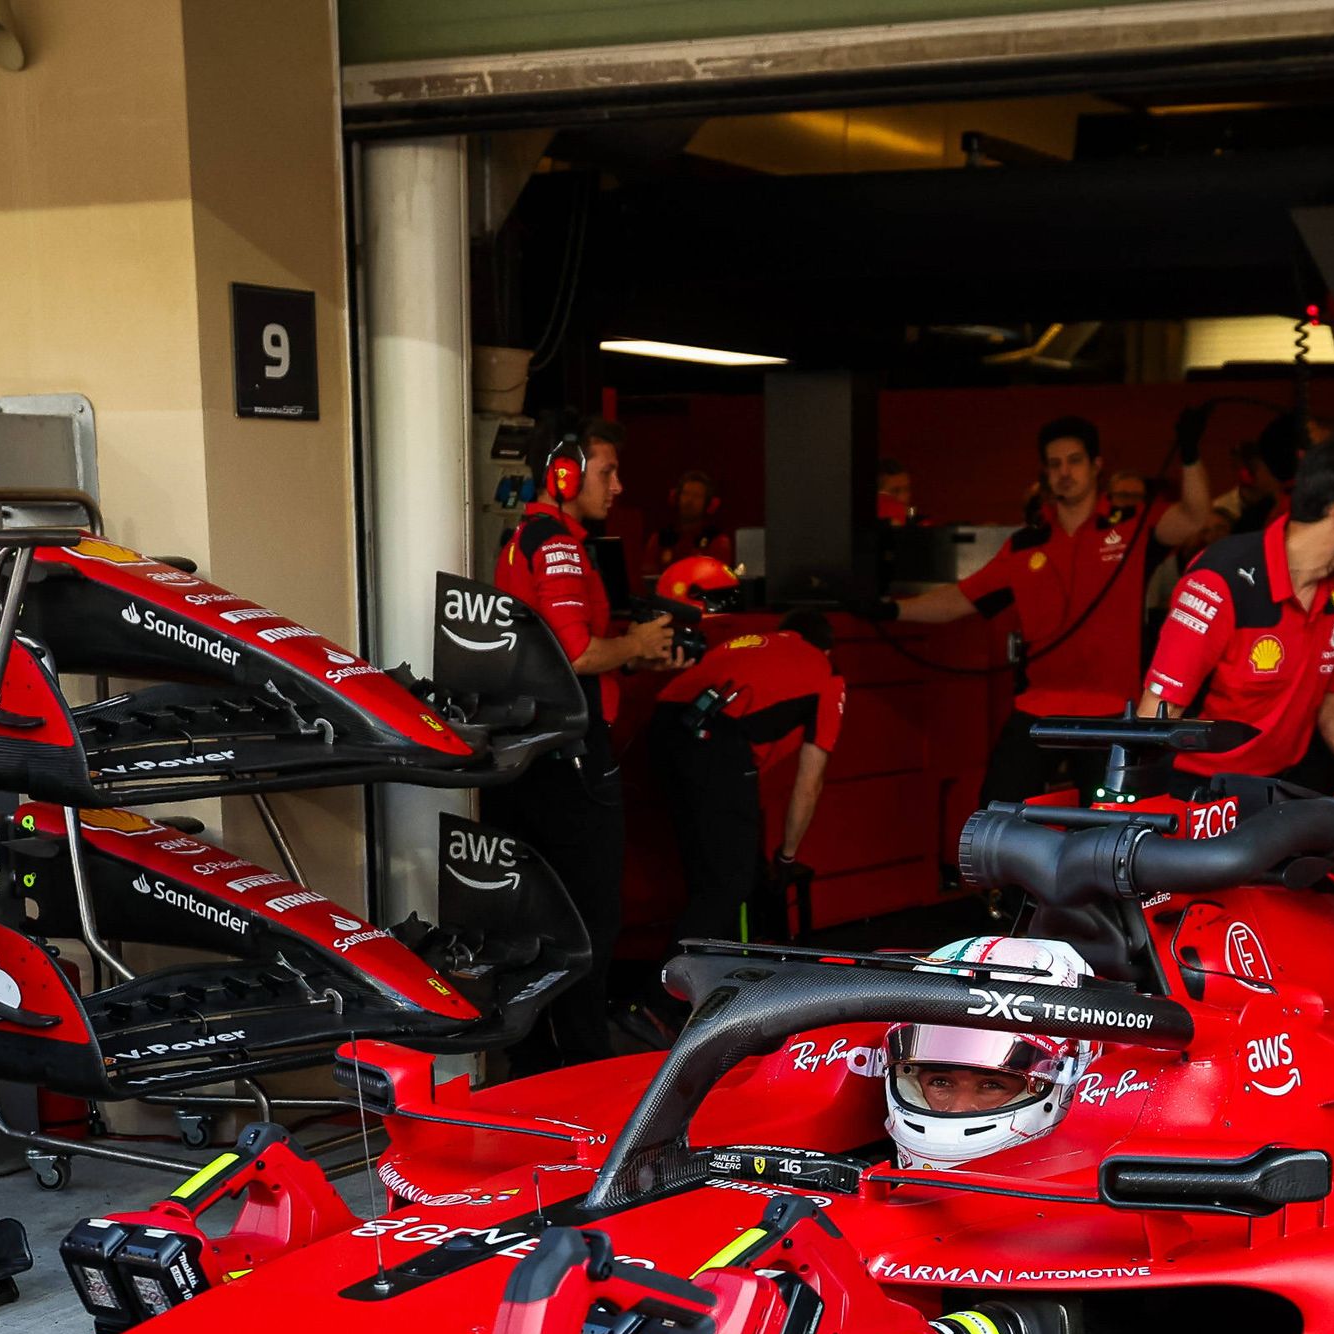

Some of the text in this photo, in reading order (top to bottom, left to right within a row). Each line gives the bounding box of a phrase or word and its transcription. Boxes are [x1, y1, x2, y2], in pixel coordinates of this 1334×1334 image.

[262, 323, 291, 378] 9
[545, 551, 581, 565] MAHLE
[445, 588, 515, 627] aws
[144, 609, 241, 667] Santander
[101, 750, 235, 774] V-Power
[448, 828, 518, 868] aws
[154, 881, 250, 935] Santander
[1142, 892, 1171, 909] LECLERC
[967, 987, 1154, 1030] DXC TECHNOLOGY
[115, 1029, 246, 1061] V-Power
[1246, 1032, 1294, 1073] aws
[1078, 1068, 1150, 1107] Ray-Ban
[377, 1162, 418, 1202] HARMAN
[778, 1158, 802, 1175] 16
[872, 1256, 1151, 1283] HARMAN AUTOMOTIVE
